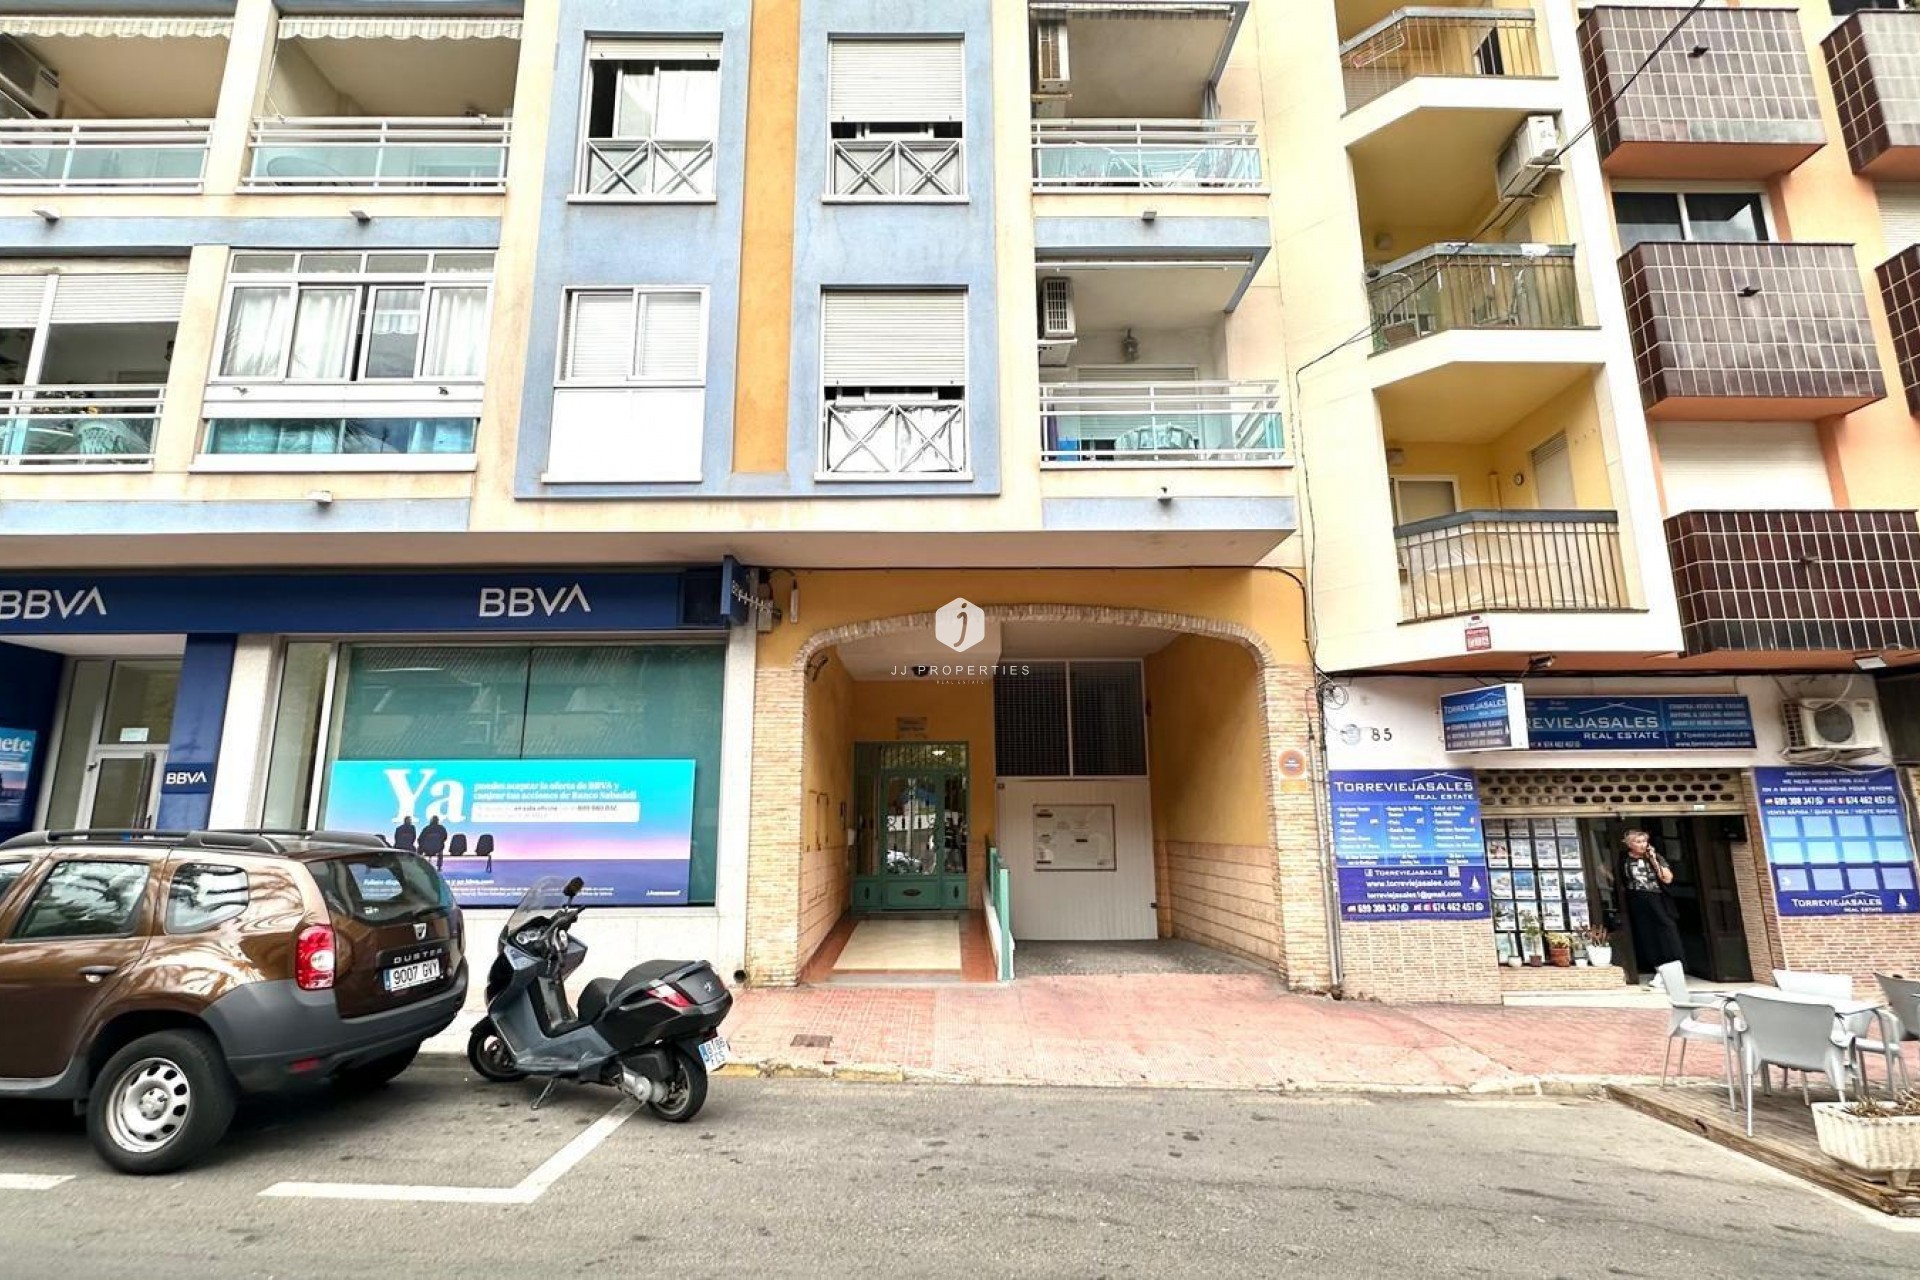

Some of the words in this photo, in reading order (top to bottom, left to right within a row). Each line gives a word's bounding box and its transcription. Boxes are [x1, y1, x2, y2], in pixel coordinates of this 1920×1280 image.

[0, 586, 107, 620] BBVA
[479, 583, 591, 617] BBVA
[1444, 699, 1507, 714] TORREVIEJASALES
[0, 736, 31, 752] ete
[166, 770, 208, 784] BBVA
[1334, 781, 1474, 792] TORREVIEJASALES
[384, 768, 466, 823] Ya
[1366, 880, 1462, 888] www.torreviejasales.com
[1791, 898, 1882, 907] TORREVIEJASALES
[393, 966, 418, 984] 9007
